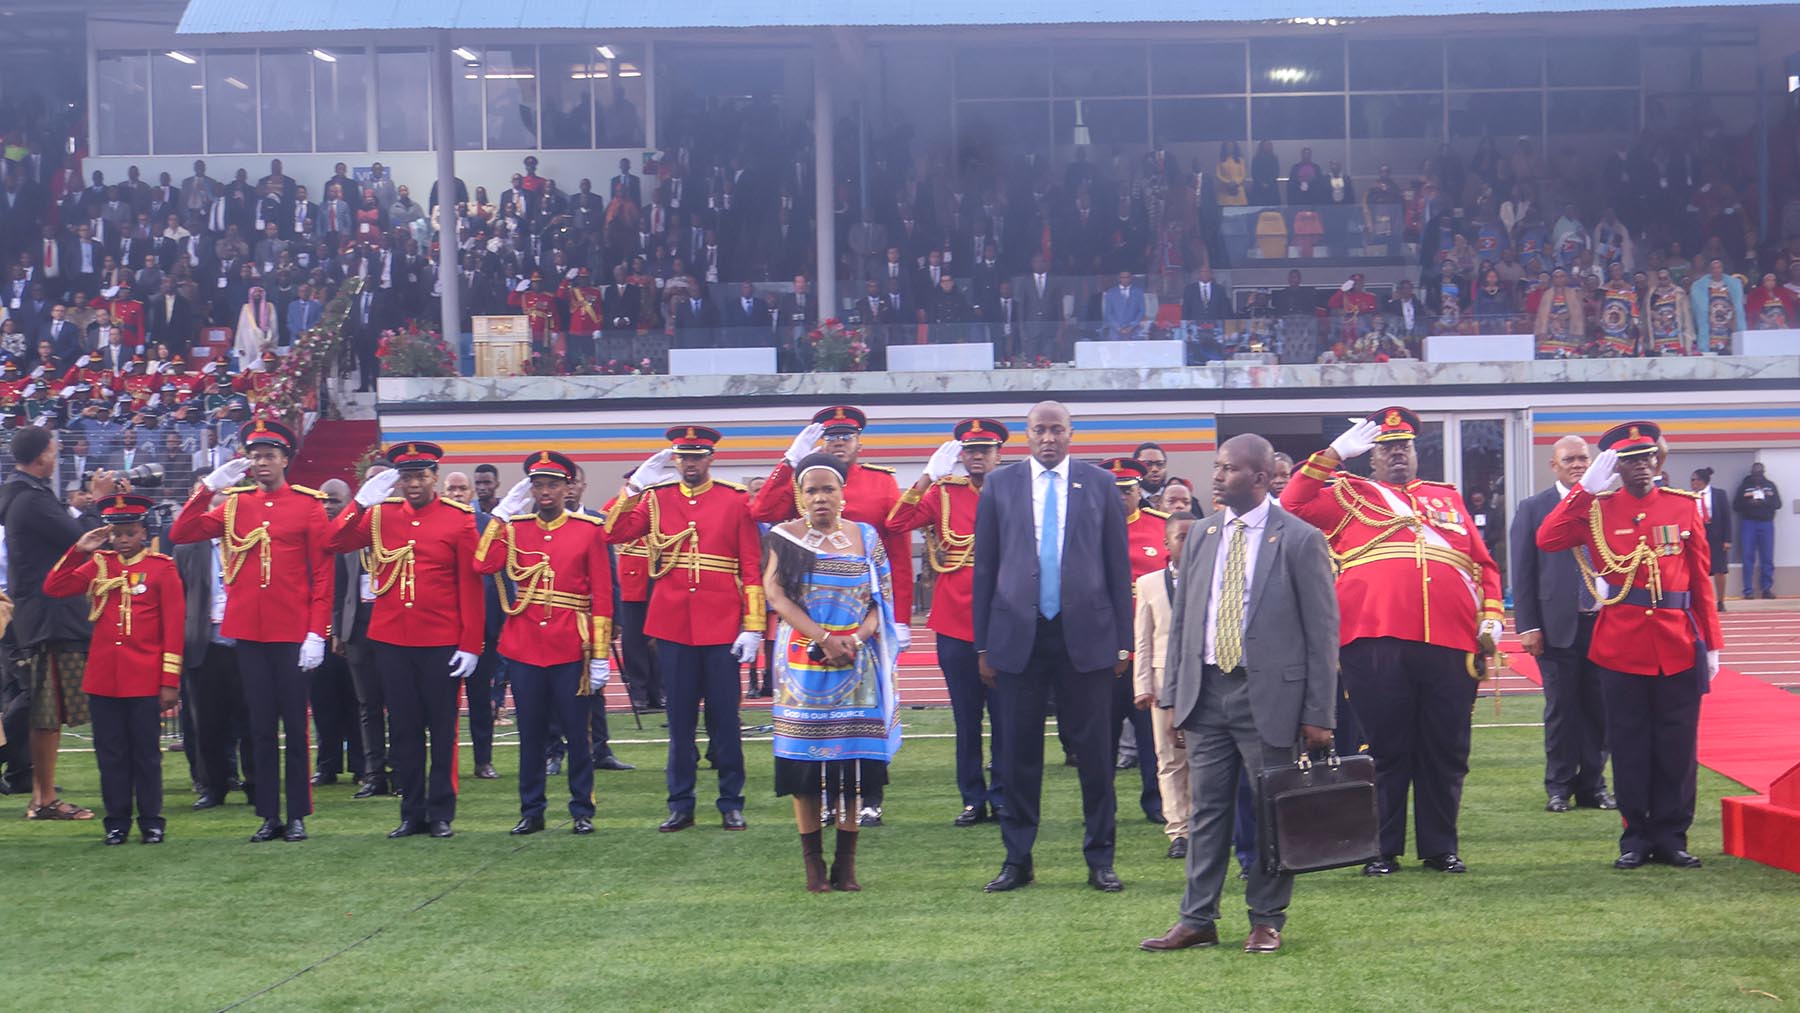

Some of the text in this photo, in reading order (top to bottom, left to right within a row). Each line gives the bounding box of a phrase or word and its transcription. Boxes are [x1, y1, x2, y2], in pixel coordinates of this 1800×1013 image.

[783, 709, 800, 718] GOD
[811, 712, 828, 720] OUR
[829, 710, 865, 719] SOURCE
